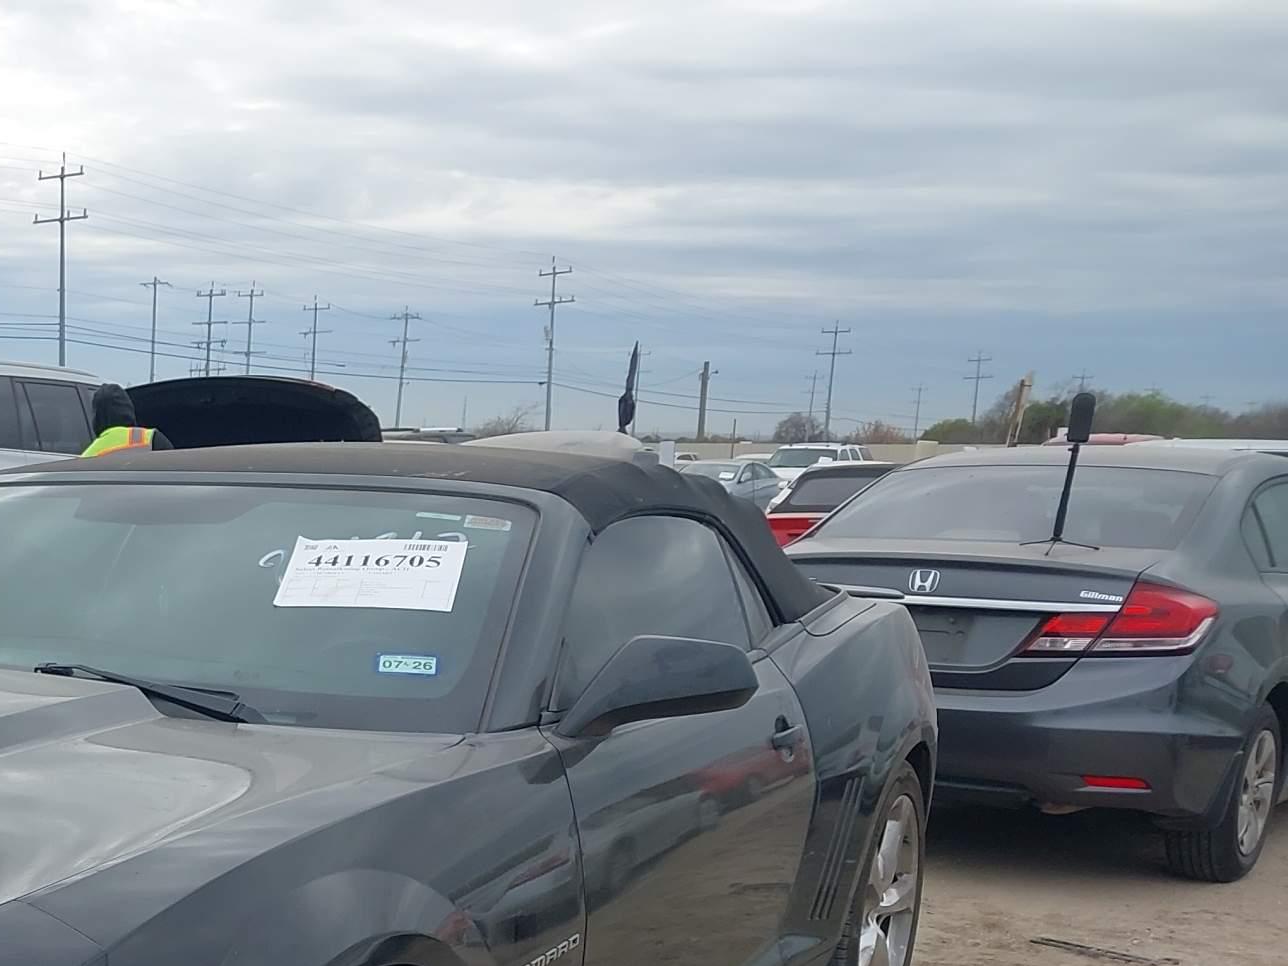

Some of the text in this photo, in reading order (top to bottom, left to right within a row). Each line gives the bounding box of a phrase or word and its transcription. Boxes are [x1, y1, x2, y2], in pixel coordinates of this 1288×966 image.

[308, 554, 442, 569] 44116705
[382, 660, 433, 671] 07 26
